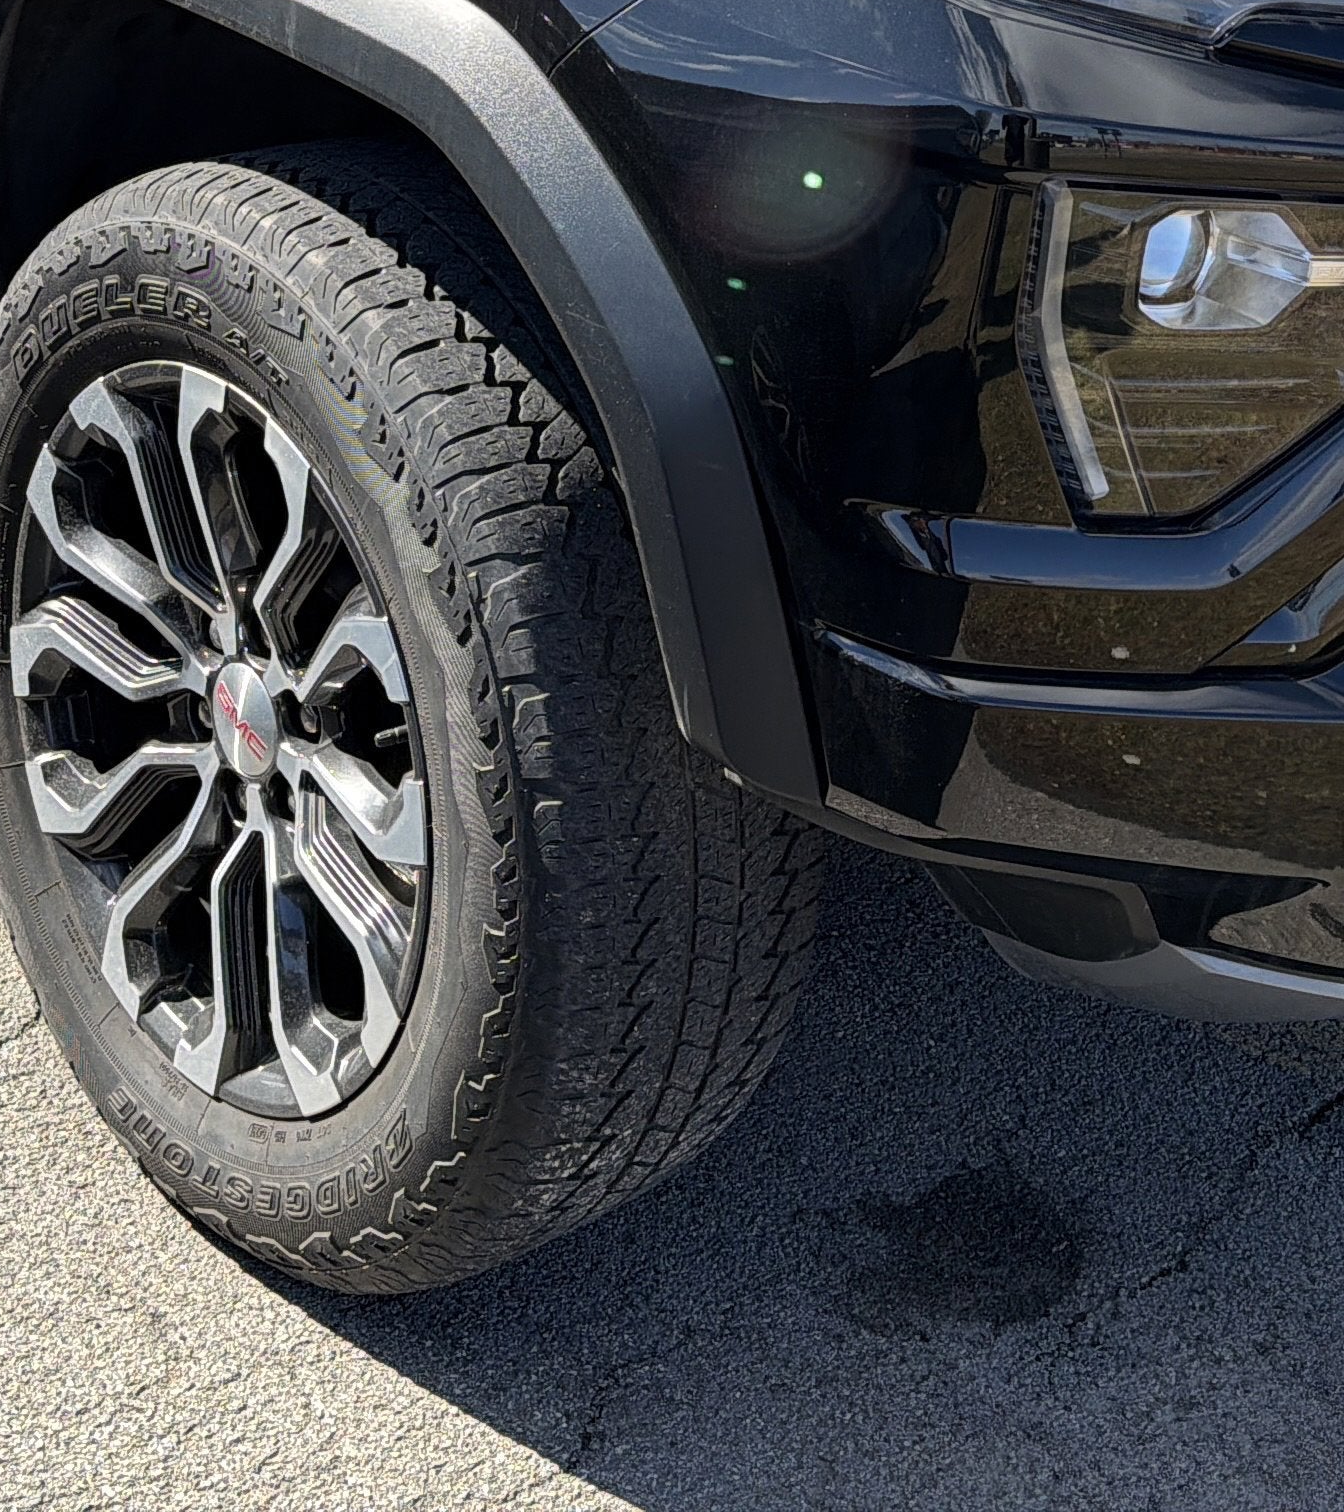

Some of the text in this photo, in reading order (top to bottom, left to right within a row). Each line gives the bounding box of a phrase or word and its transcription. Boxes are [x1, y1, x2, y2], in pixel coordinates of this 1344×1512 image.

[11, 273, 212, 386] DUELER
[217, 680, 268, 761] GMC
[106, 1085, 414, 1223] BRIDGESTONE
